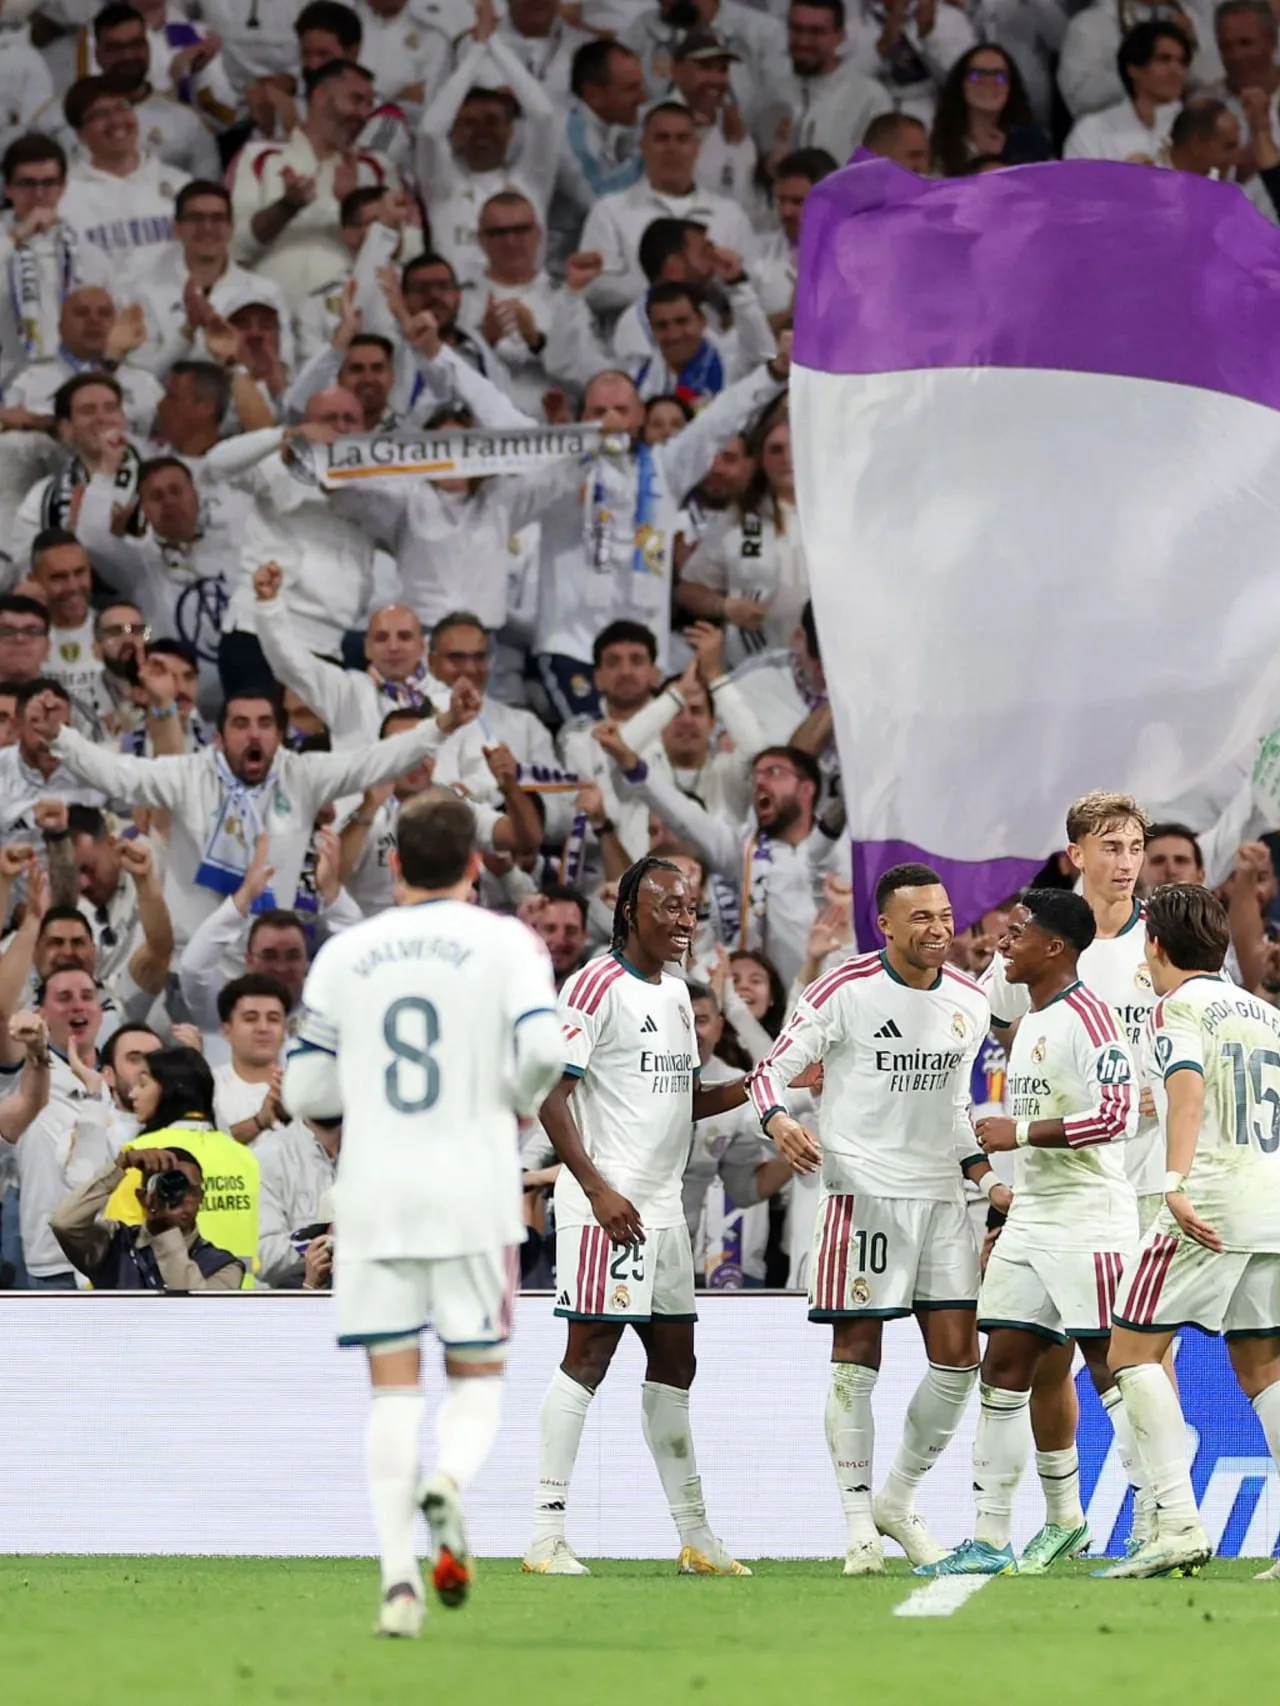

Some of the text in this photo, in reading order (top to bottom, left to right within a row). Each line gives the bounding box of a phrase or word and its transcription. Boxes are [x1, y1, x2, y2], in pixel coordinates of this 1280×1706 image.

[327, 442, 362, 468] La
[370, 437, 450, 464] Gran
[1201, 999, 1234, 1036] ARDA
[383, 996, 441, 1114] 8
[1100, 1050, 1129, 1084] hp
[204, 1175, 245, 1192] VICIOS
[609, 1240, 646, 1281] 25
[854, 1230, 888, 1274] 10
